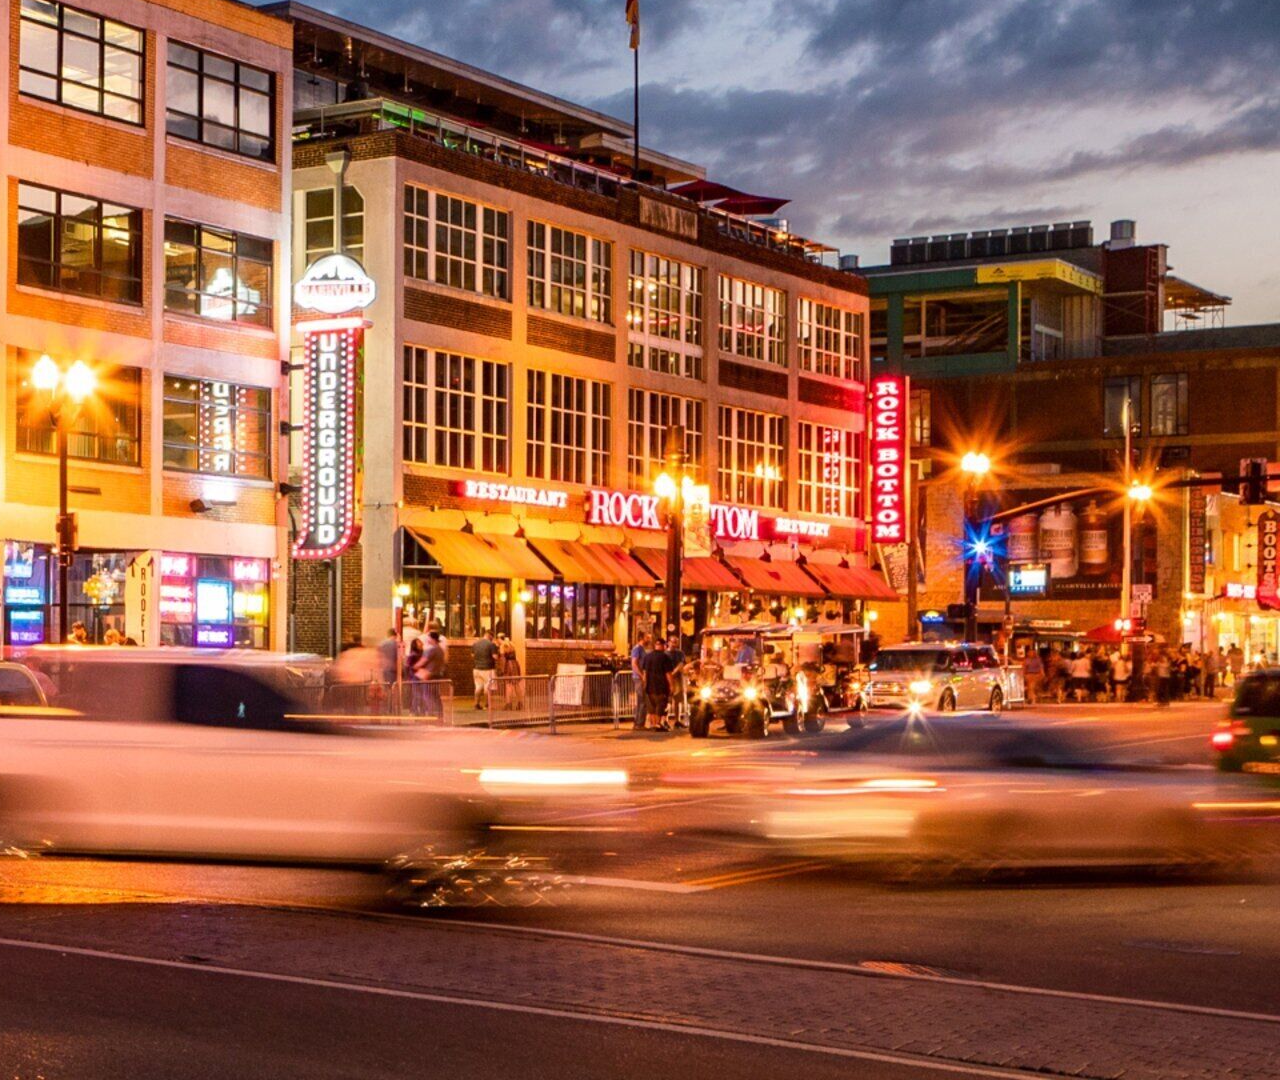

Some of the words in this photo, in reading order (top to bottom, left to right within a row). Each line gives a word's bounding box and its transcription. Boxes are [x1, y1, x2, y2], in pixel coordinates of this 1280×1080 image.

[317, 332, 337, 545] UNDERGROUND
[875, 381, 900, 441] ROCK
[465, 479, 568, 508] RESTAURANT
[591, 490, 661, 530] ROCK
[875, 447, 900, 539] BOTTOM
[775, 516, 831, 537] BREWERY
[1262, 520, 1277, 586] BOOTS
